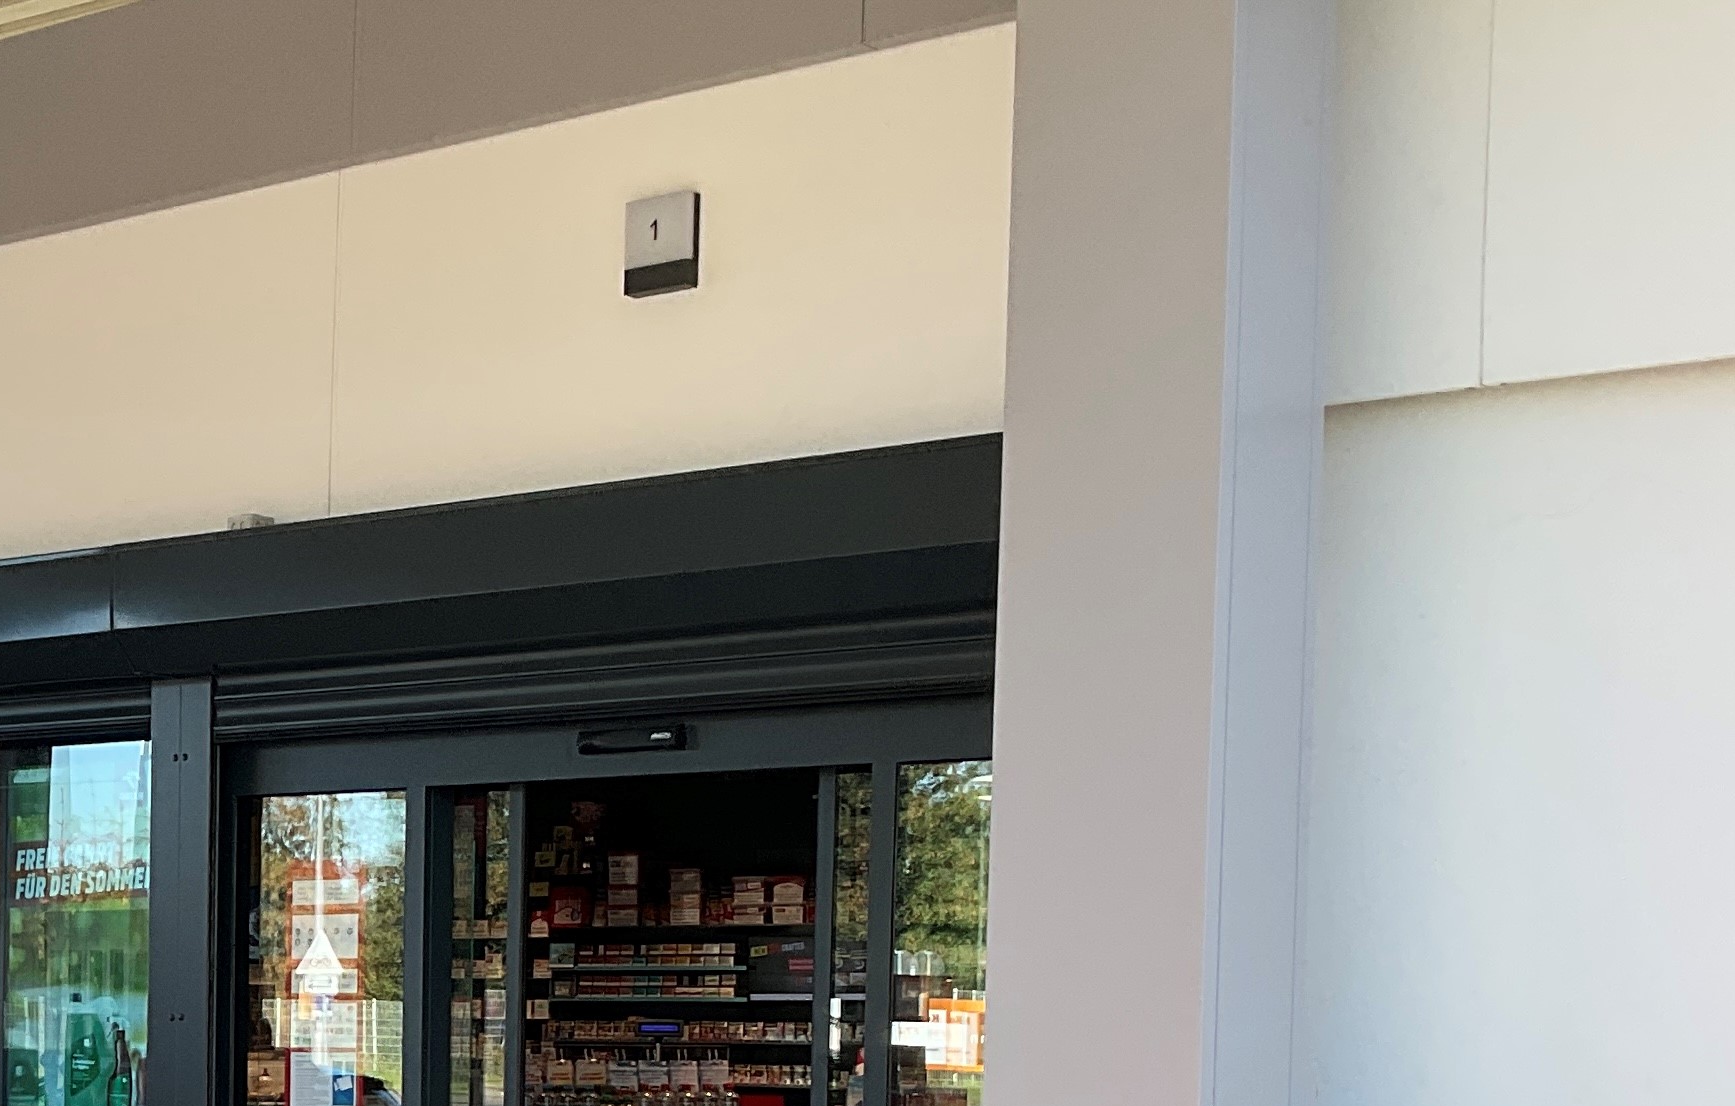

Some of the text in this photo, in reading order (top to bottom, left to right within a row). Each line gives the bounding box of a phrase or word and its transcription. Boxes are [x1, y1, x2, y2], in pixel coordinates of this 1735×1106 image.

[649, 217, 659, 241] 1
[15, 872, 47, 900] FÜR
[49, 871, 82, 897] DEN
